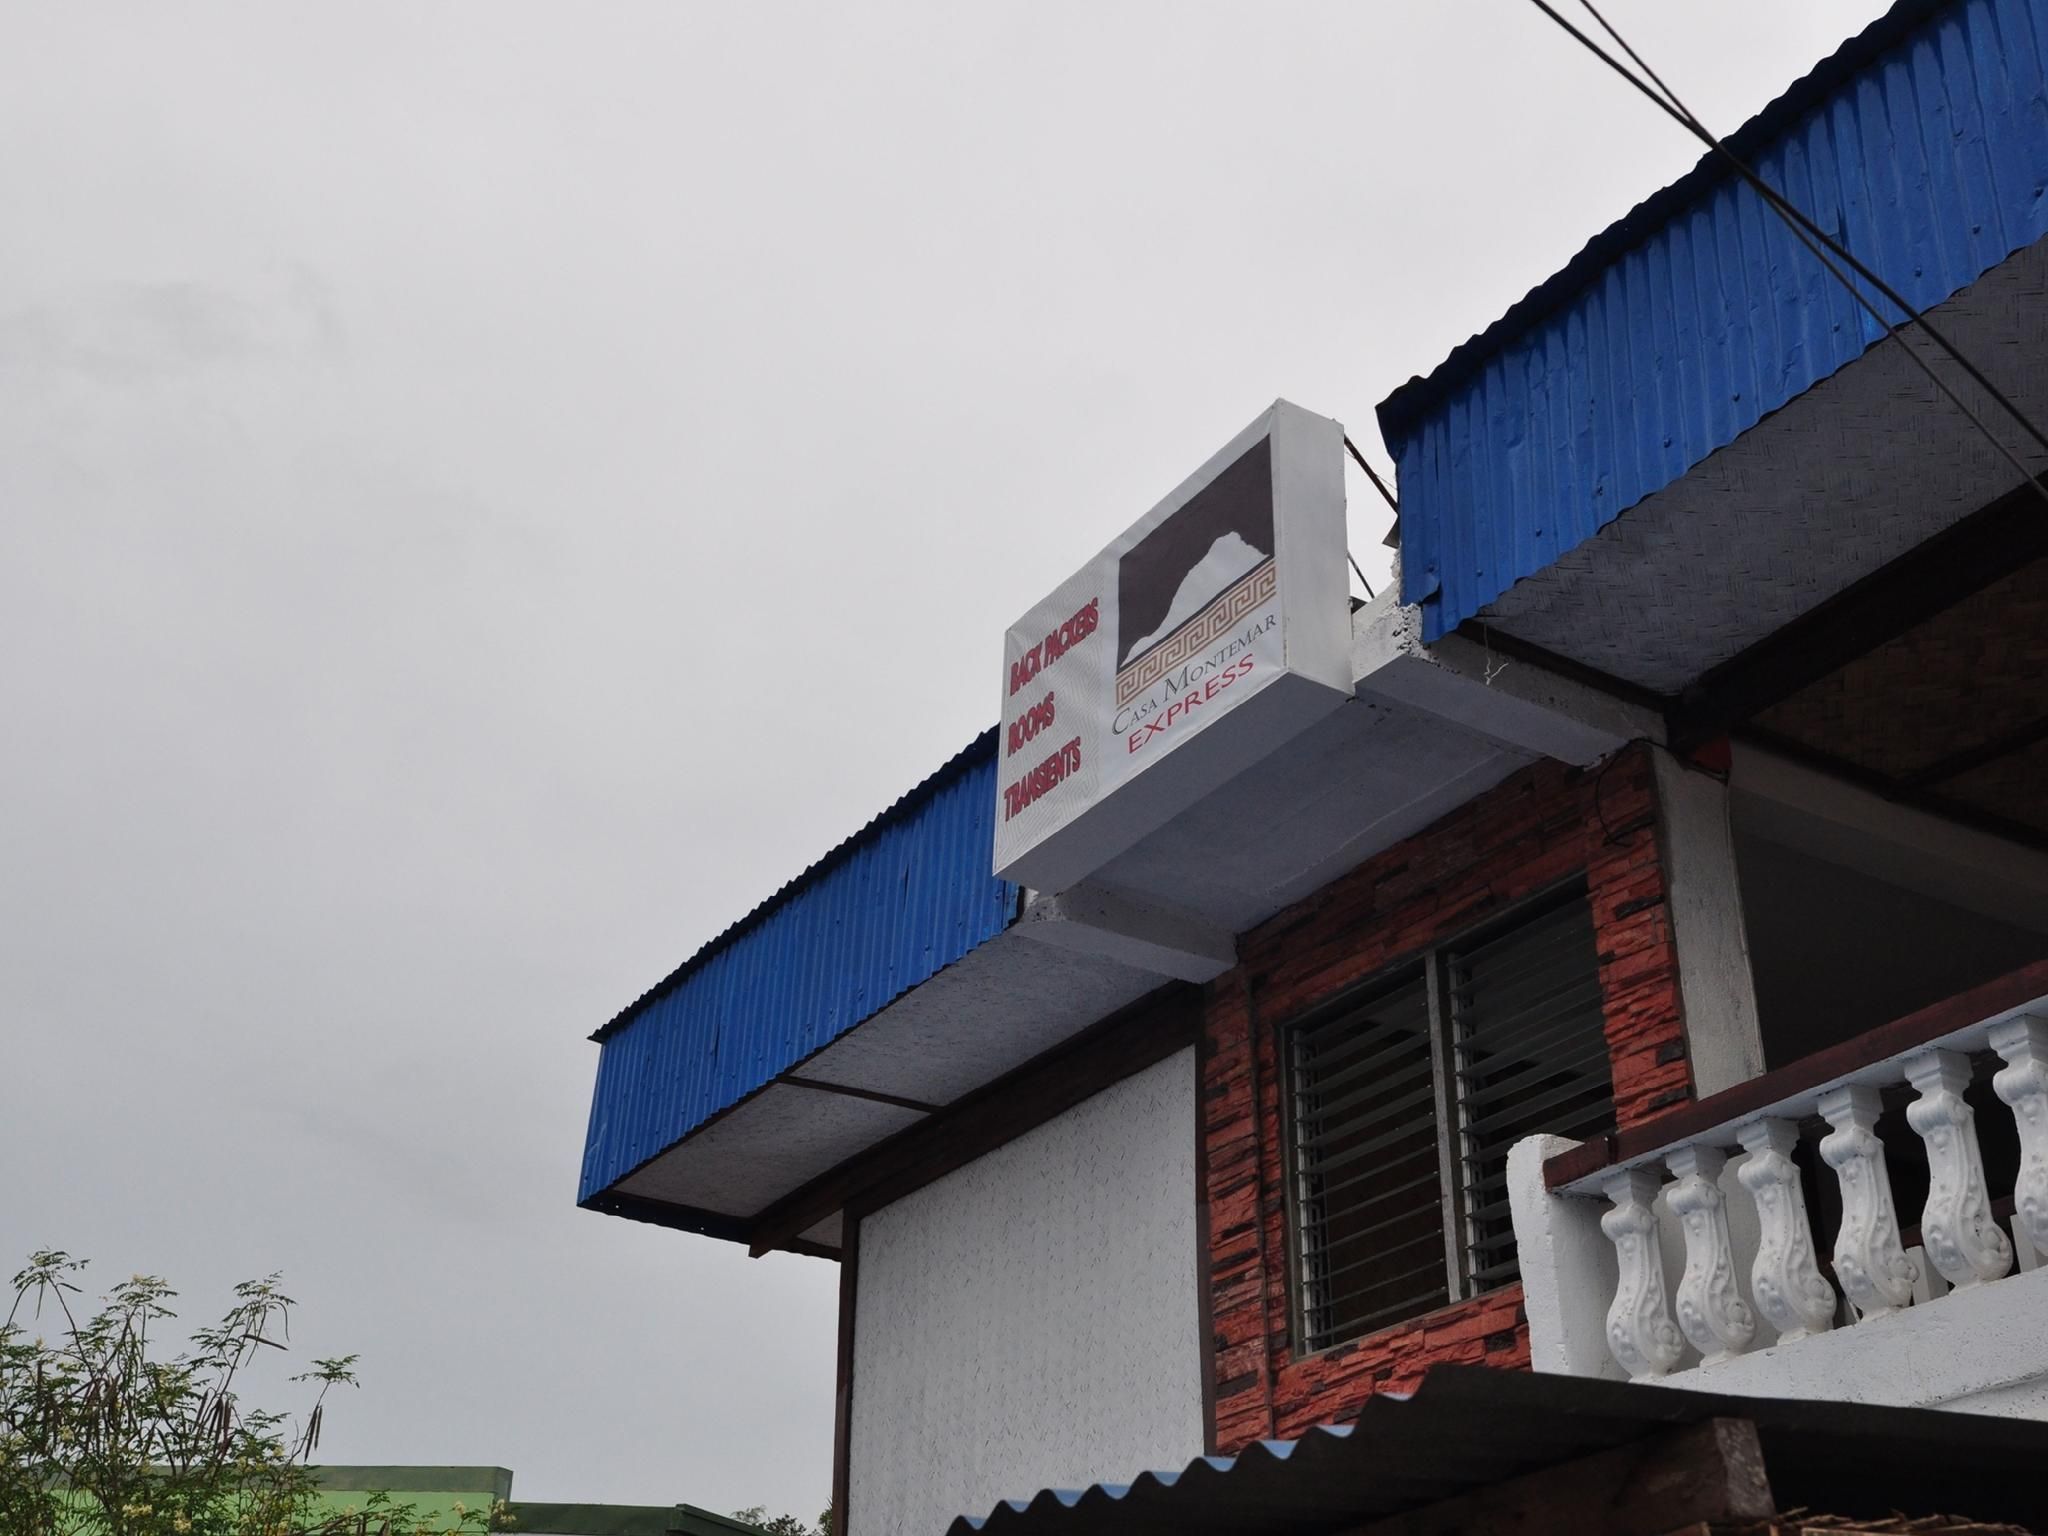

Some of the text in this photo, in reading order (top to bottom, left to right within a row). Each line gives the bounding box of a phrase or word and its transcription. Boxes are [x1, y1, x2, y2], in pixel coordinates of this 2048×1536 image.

[1010, 597, 1098, 696] BACK PACKERS
[1007, 692, 1055, 758] ROOMS
[1129, 653, 1255, 754] EXPRESS
[1004, 736, 1081, 822] TRANSIENTS
